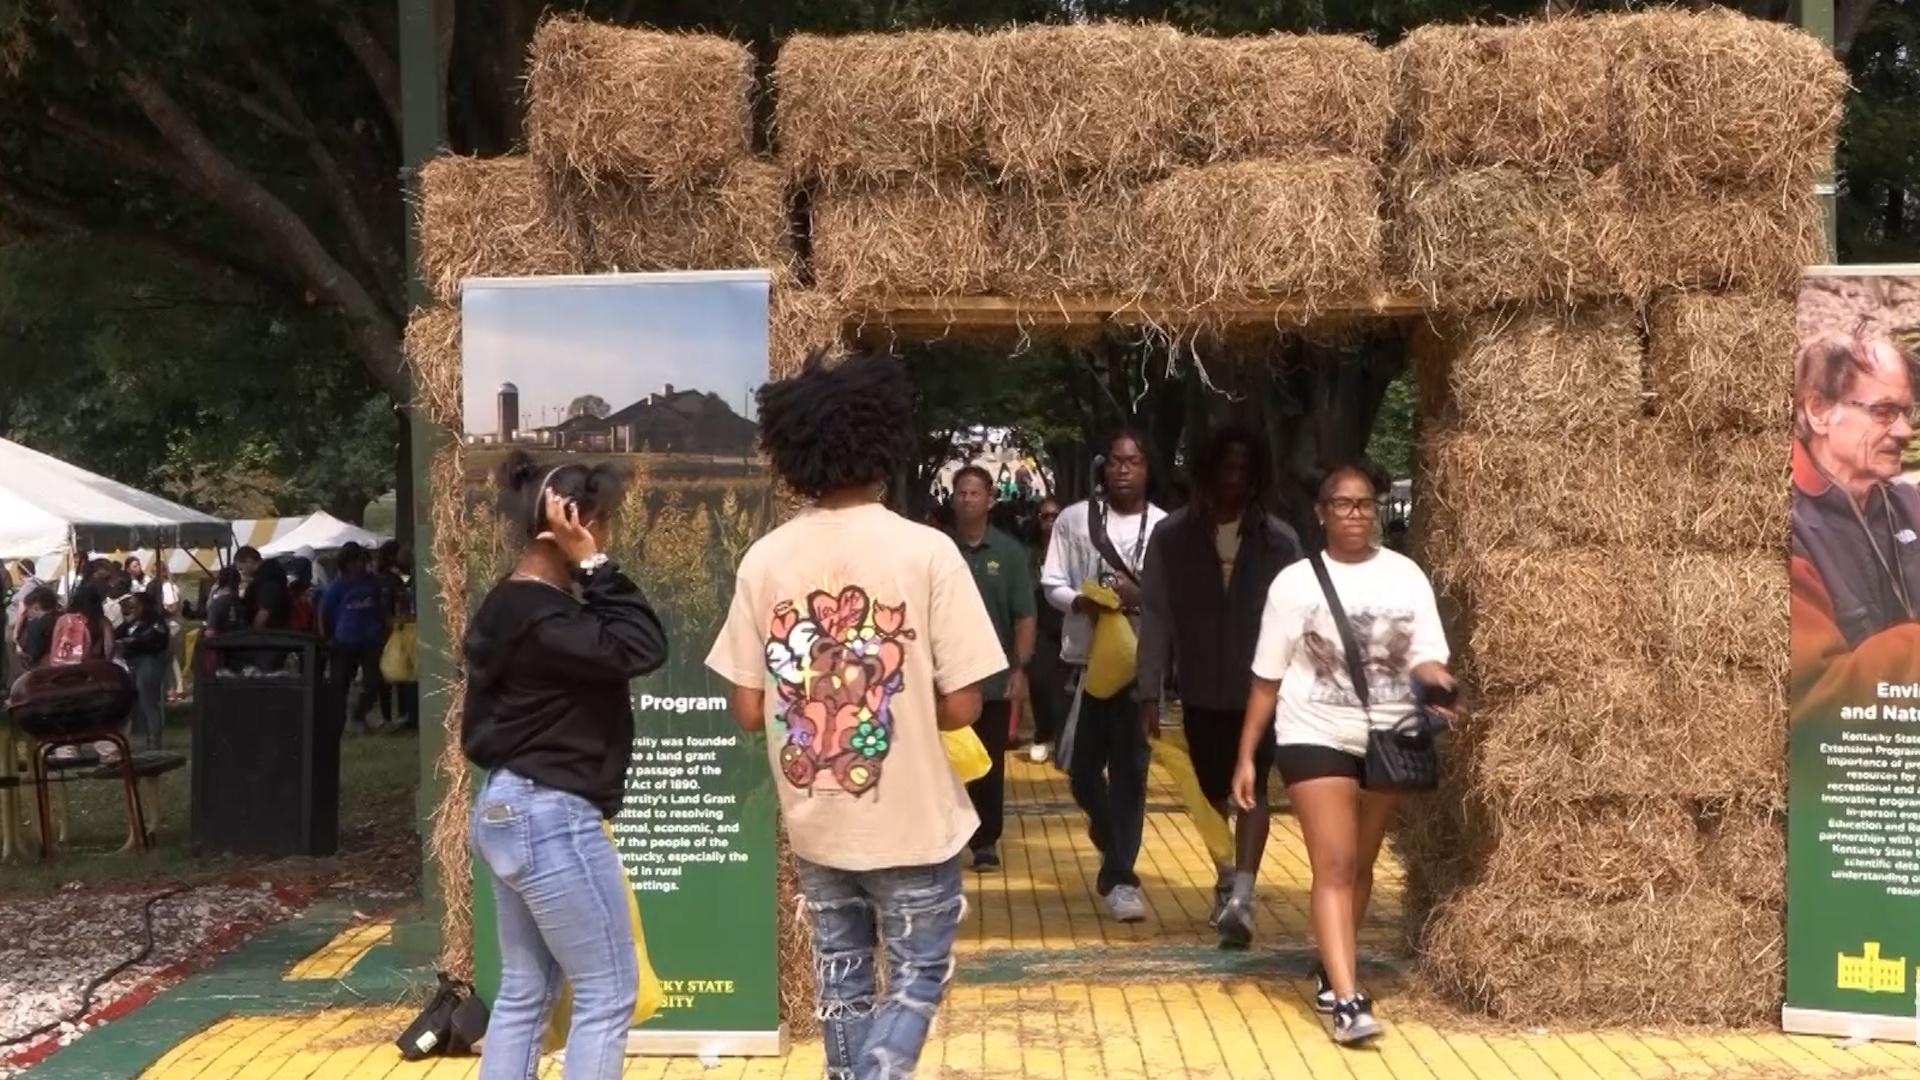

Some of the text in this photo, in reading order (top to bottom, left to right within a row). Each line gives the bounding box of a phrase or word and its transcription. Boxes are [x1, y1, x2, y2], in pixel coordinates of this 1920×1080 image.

[1876, 682, 1920, 698] Envi
[641, 695, 728, 714] Program
[1840, 704, 1877, 720] and
[661, 738, 684, 747] was
[686, 736, 736, 747] founded
[1842, 732, 1892, 744] Kentucky
[1820, 743, 1873, 754] Extension
[646, 753, 654, 761] a
[656, 751, 682, 761] land
[684, 752, 717, 763] grant
[1890, 758, 1903, 768] of
[636, 767, 684, 778] passage
[686, 765, 701, 775] of
[702, 765, 723, 775] the
[1846, 771, 1898, 780] resources
[1901, 771, 1917, 782] for
[631, 779, 652, 789] Act
[654, 779, 668, 790] of
[670, 779, 702, 790] 1890.
[1827, 783, 1892, 793] recreational
[1894, 784, 1915, 794] and
[622, 793, 737, 806] ersity's Land Grant
[654, 809, 667, 818] to
[670, 808, 725, 821] resolving
[653, 822, 715, 834] economic,
[717, 822, 740, 833] and
[1828, 818, 1883, 830] Education
[1884, 822, 1906, 833] and
[627, 837, 648, 847] the
[650, 837, 691, 849] people
[693, 837, 707, 847] of
[709, 837, 729, 847] the
[1818, 832, 1887, 845] partnerships
[1888, 835, 1913, 845] with
[1832, 844, 1882, 856] Kentucky
[1885, 847, 1914, 858] State
[668, 852, 726, 864] especially
[728, 852, 749, 863] the
[641, 866, 653, 876] in
[655, 866, 682, 876] rural
[1894, 861, 1920, 871] data
[1832, 871, 1909, 884] understanding
[687, 980, 735, 993] STATE
